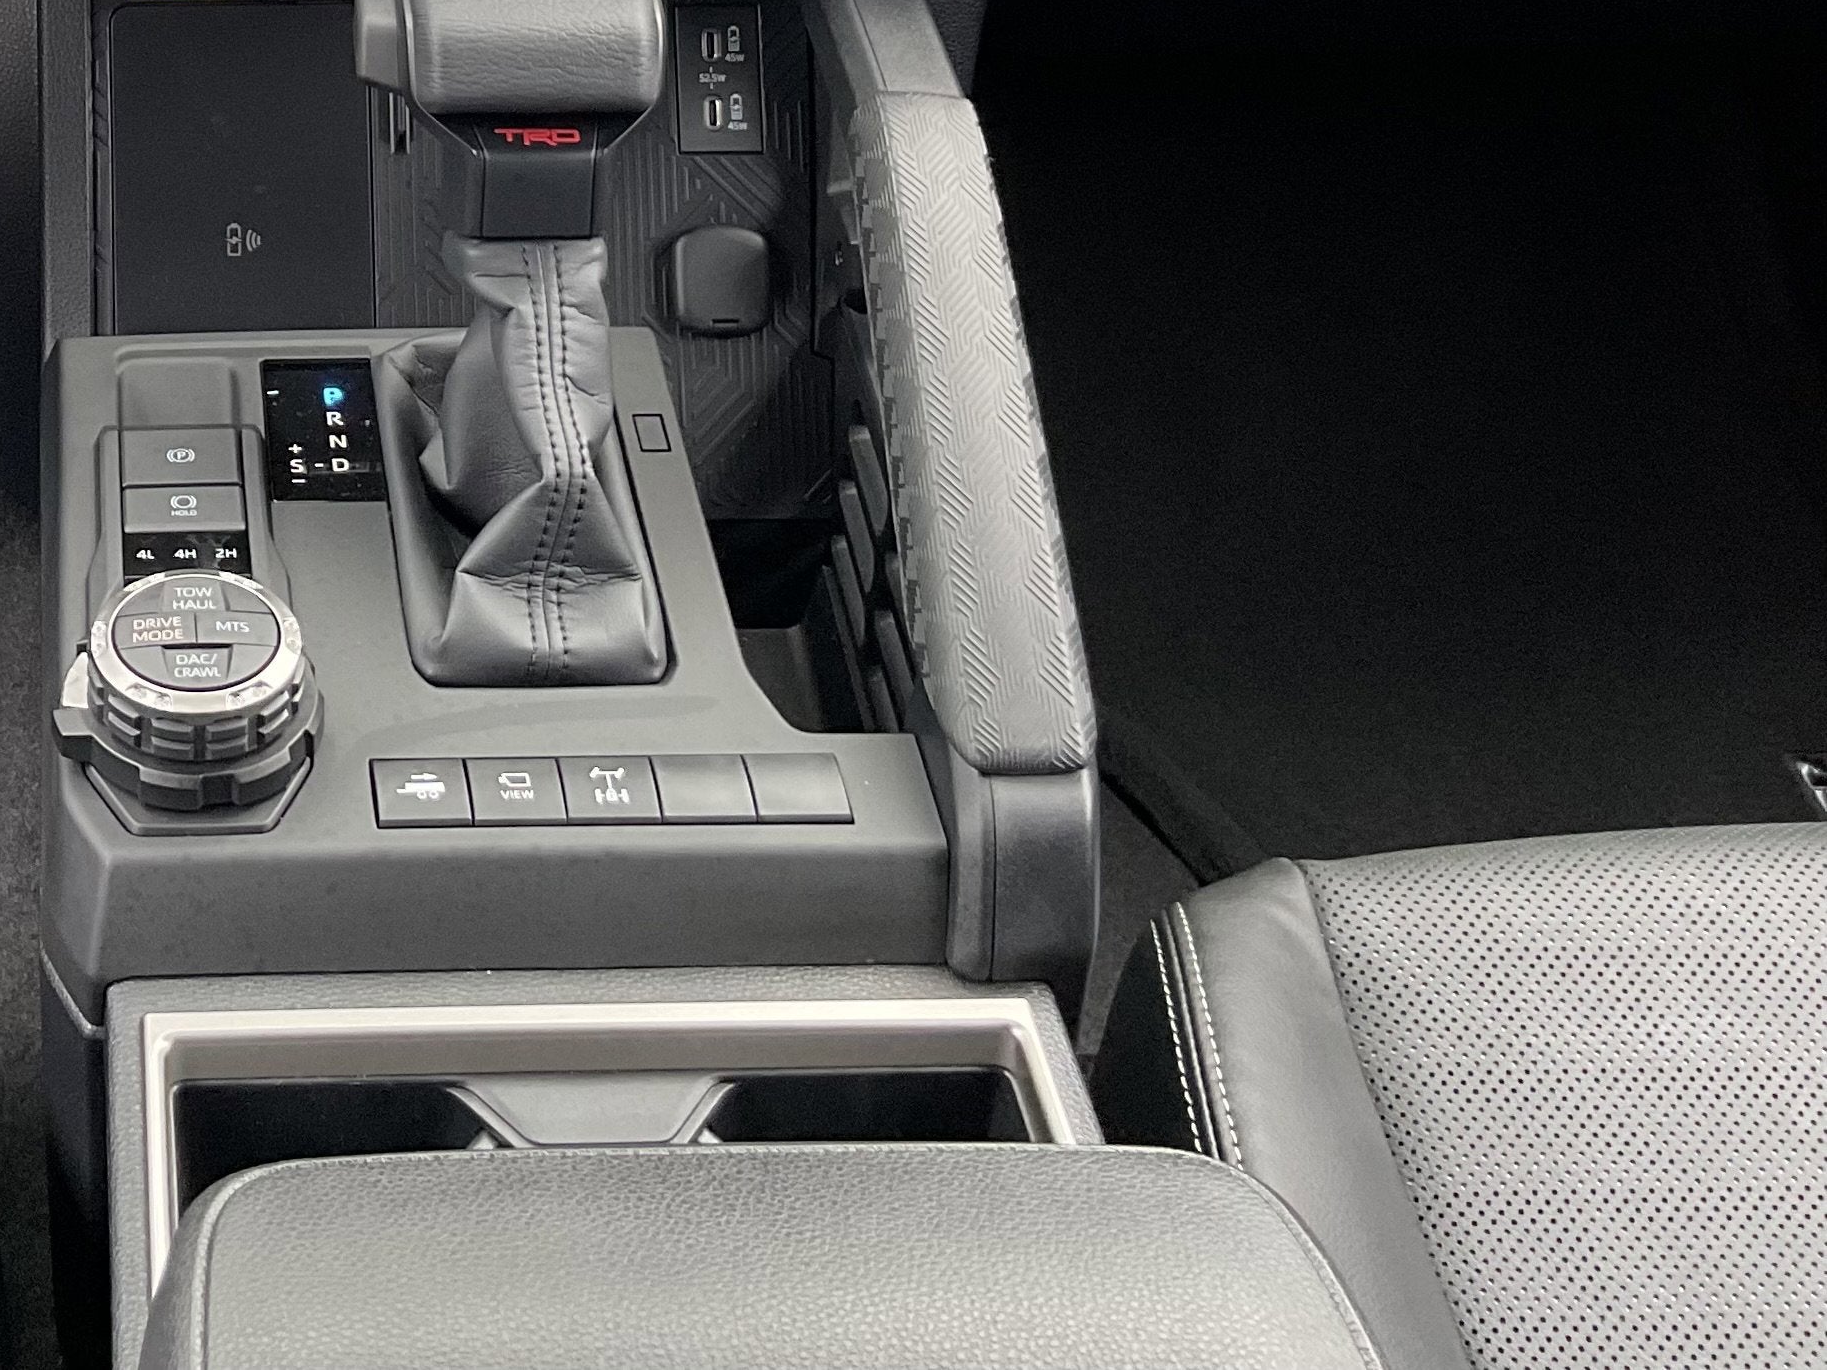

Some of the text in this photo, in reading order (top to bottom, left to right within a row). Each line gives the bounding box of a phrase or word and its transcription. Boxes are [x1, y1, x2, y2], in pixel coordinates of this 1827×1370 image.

[725, 52, 745, 62] 45W
[727, 121, 748, 130] 45W
[493, 128, 581, 146] TRD
[323, 387, 344, 407] P
[326, 411, 344, 426] R
[329, 434, 347, 449] N
[290, 458, 350, 474] S D
[170, 509, 198, 517] HOLD
[136, 549, 155, 560] 4L
[174, 548, 197, 559] 4H
[215, 548, 238, 559] 2H
[173, 587, 213, 598] TOW
[172, 599, 217, 610] HAUL
[132, 616, 182, 629] DRIVE
[215, 621, 250, 633] MTS
[132, 629, 184, 643] MODE
[176, 653, 218, 665] DAC/
[174, 666, 222, 678] CRAWL
[500, 789, 534, 800] VIEW
